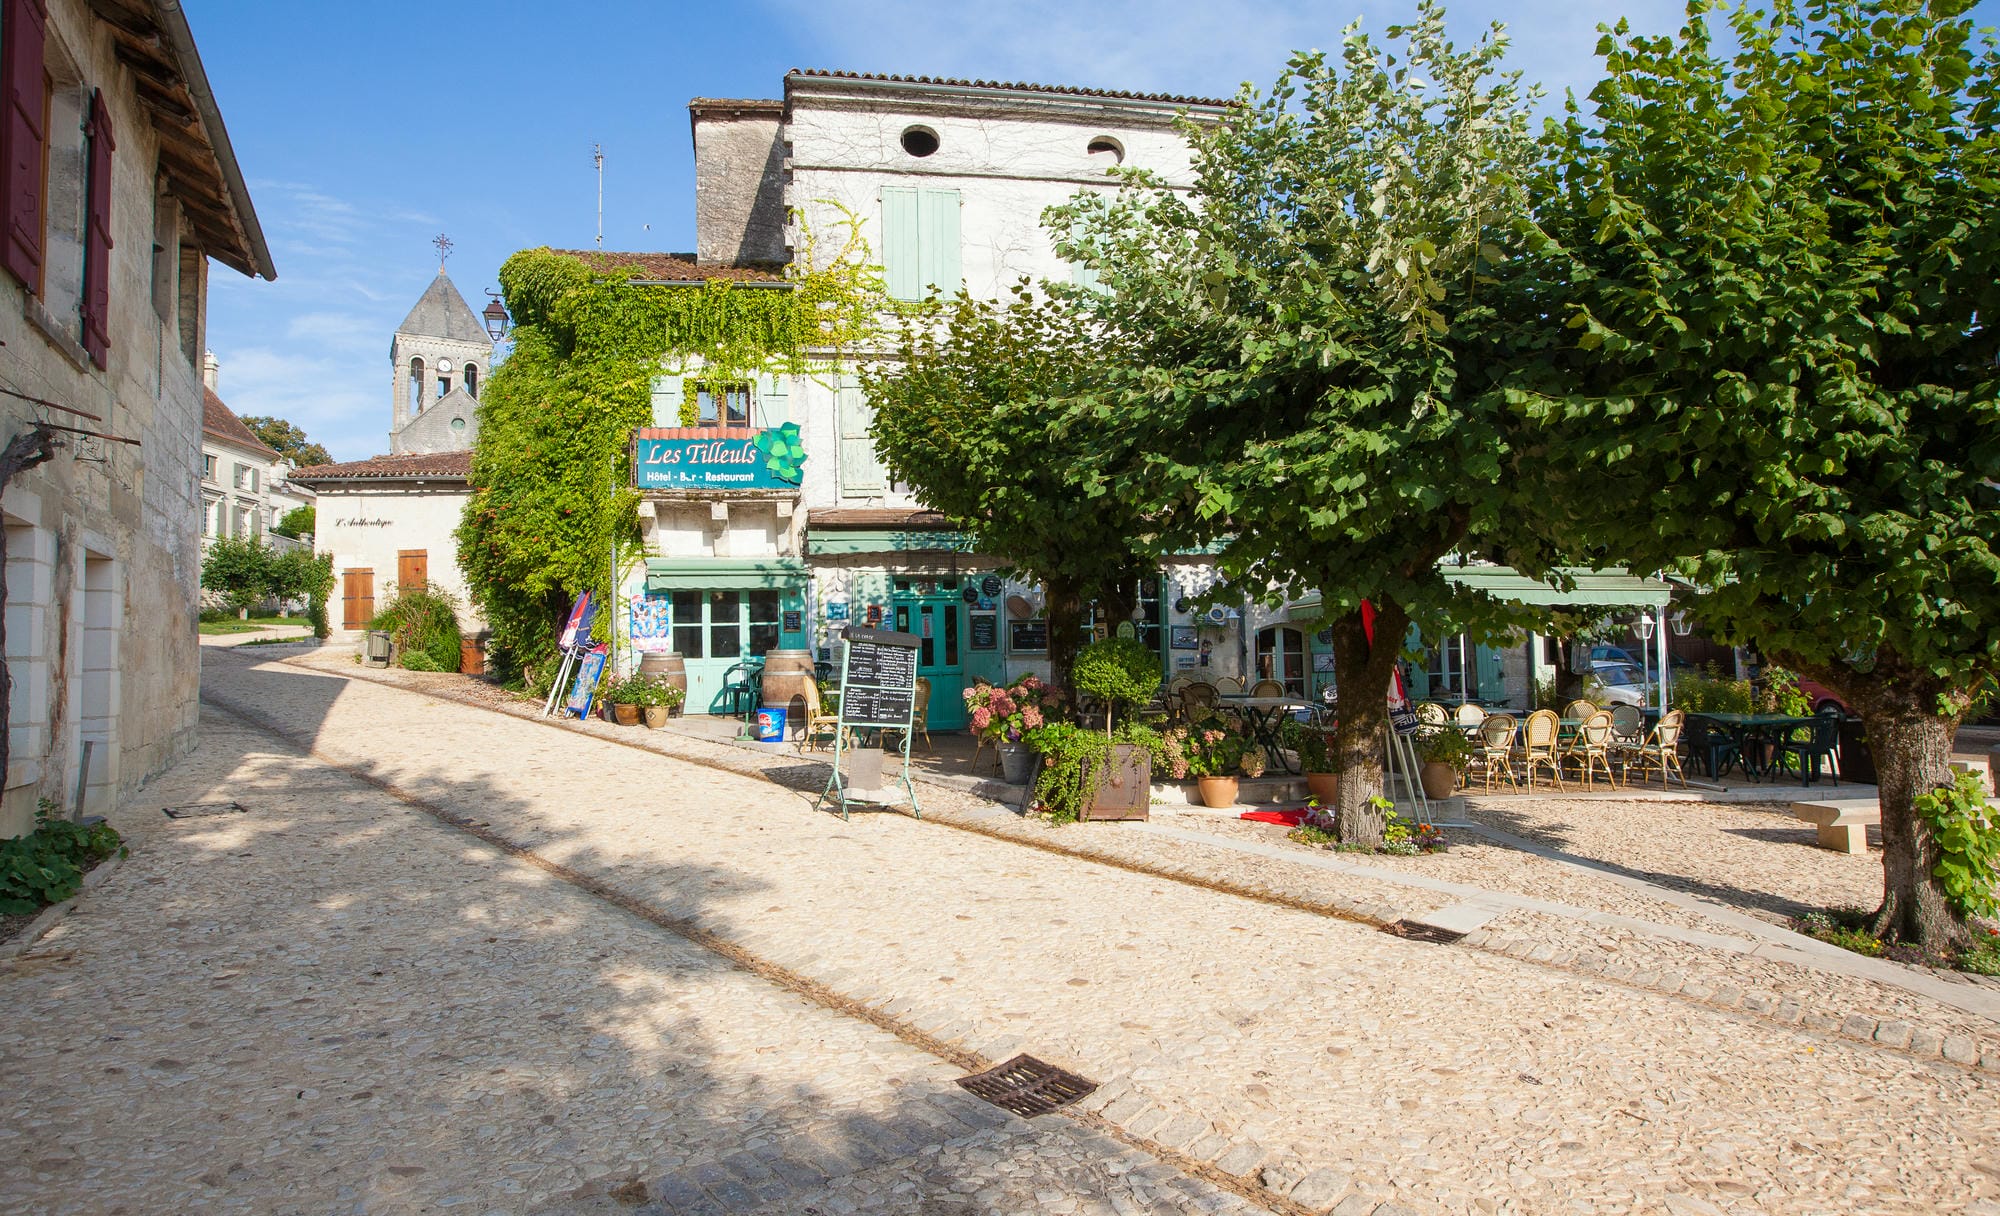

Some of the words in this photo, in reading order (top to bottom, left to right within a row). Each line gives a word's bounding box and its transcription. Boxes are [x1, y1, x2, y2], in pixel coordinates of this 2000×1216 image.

[645, 443, 680, 464] Les
[686, 441, 756, 464] Tilleuls
[647, 471, 671, 482] Hôtel
[705, 471, 755, 482] Restaurant
